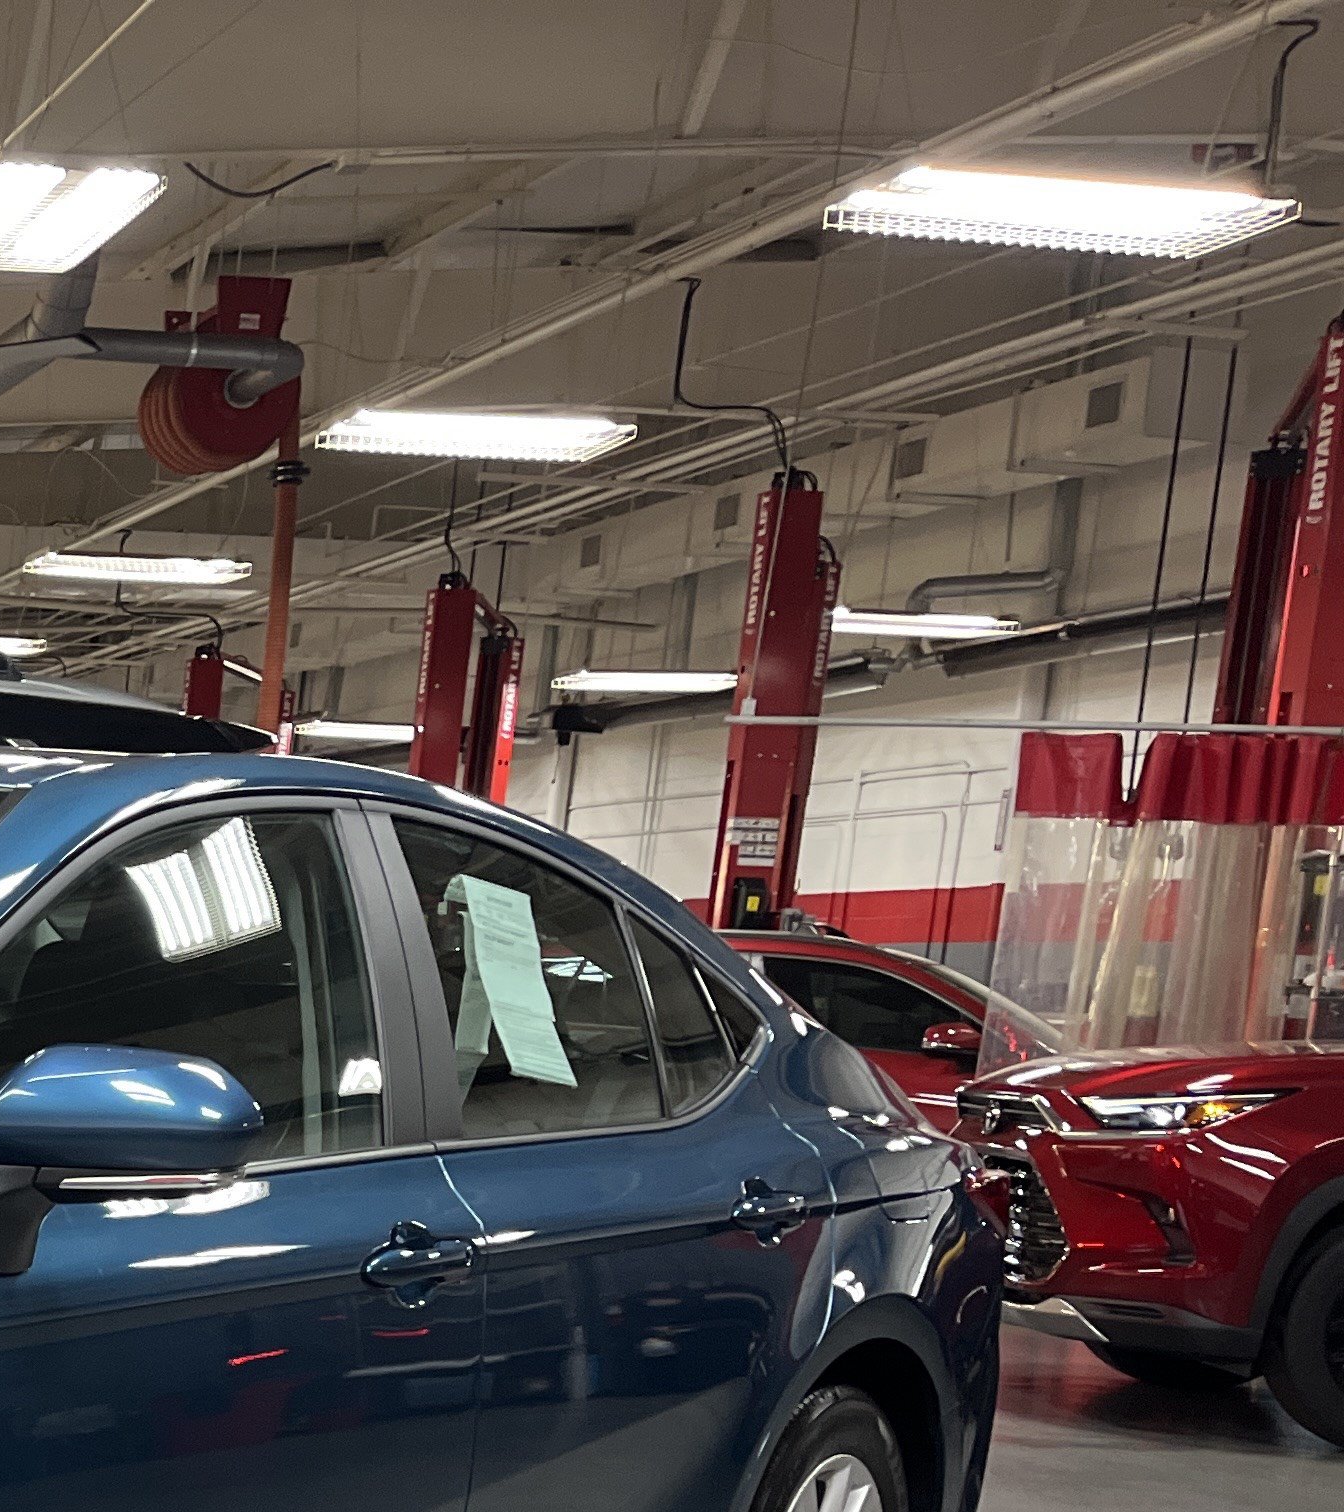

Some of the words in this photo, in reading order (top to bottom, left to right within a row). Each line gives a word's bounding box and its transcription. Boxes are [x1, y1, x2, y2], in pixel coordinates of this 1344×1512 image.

[1322, 336, 1344, 394] LIFT
[1308, 402, 1337, 511] ROTARY
[746, 543, 765, 625] ROTARY
[758, 495, 772, 537] LIFT
[502, 673, 518, 732] ROTARY
